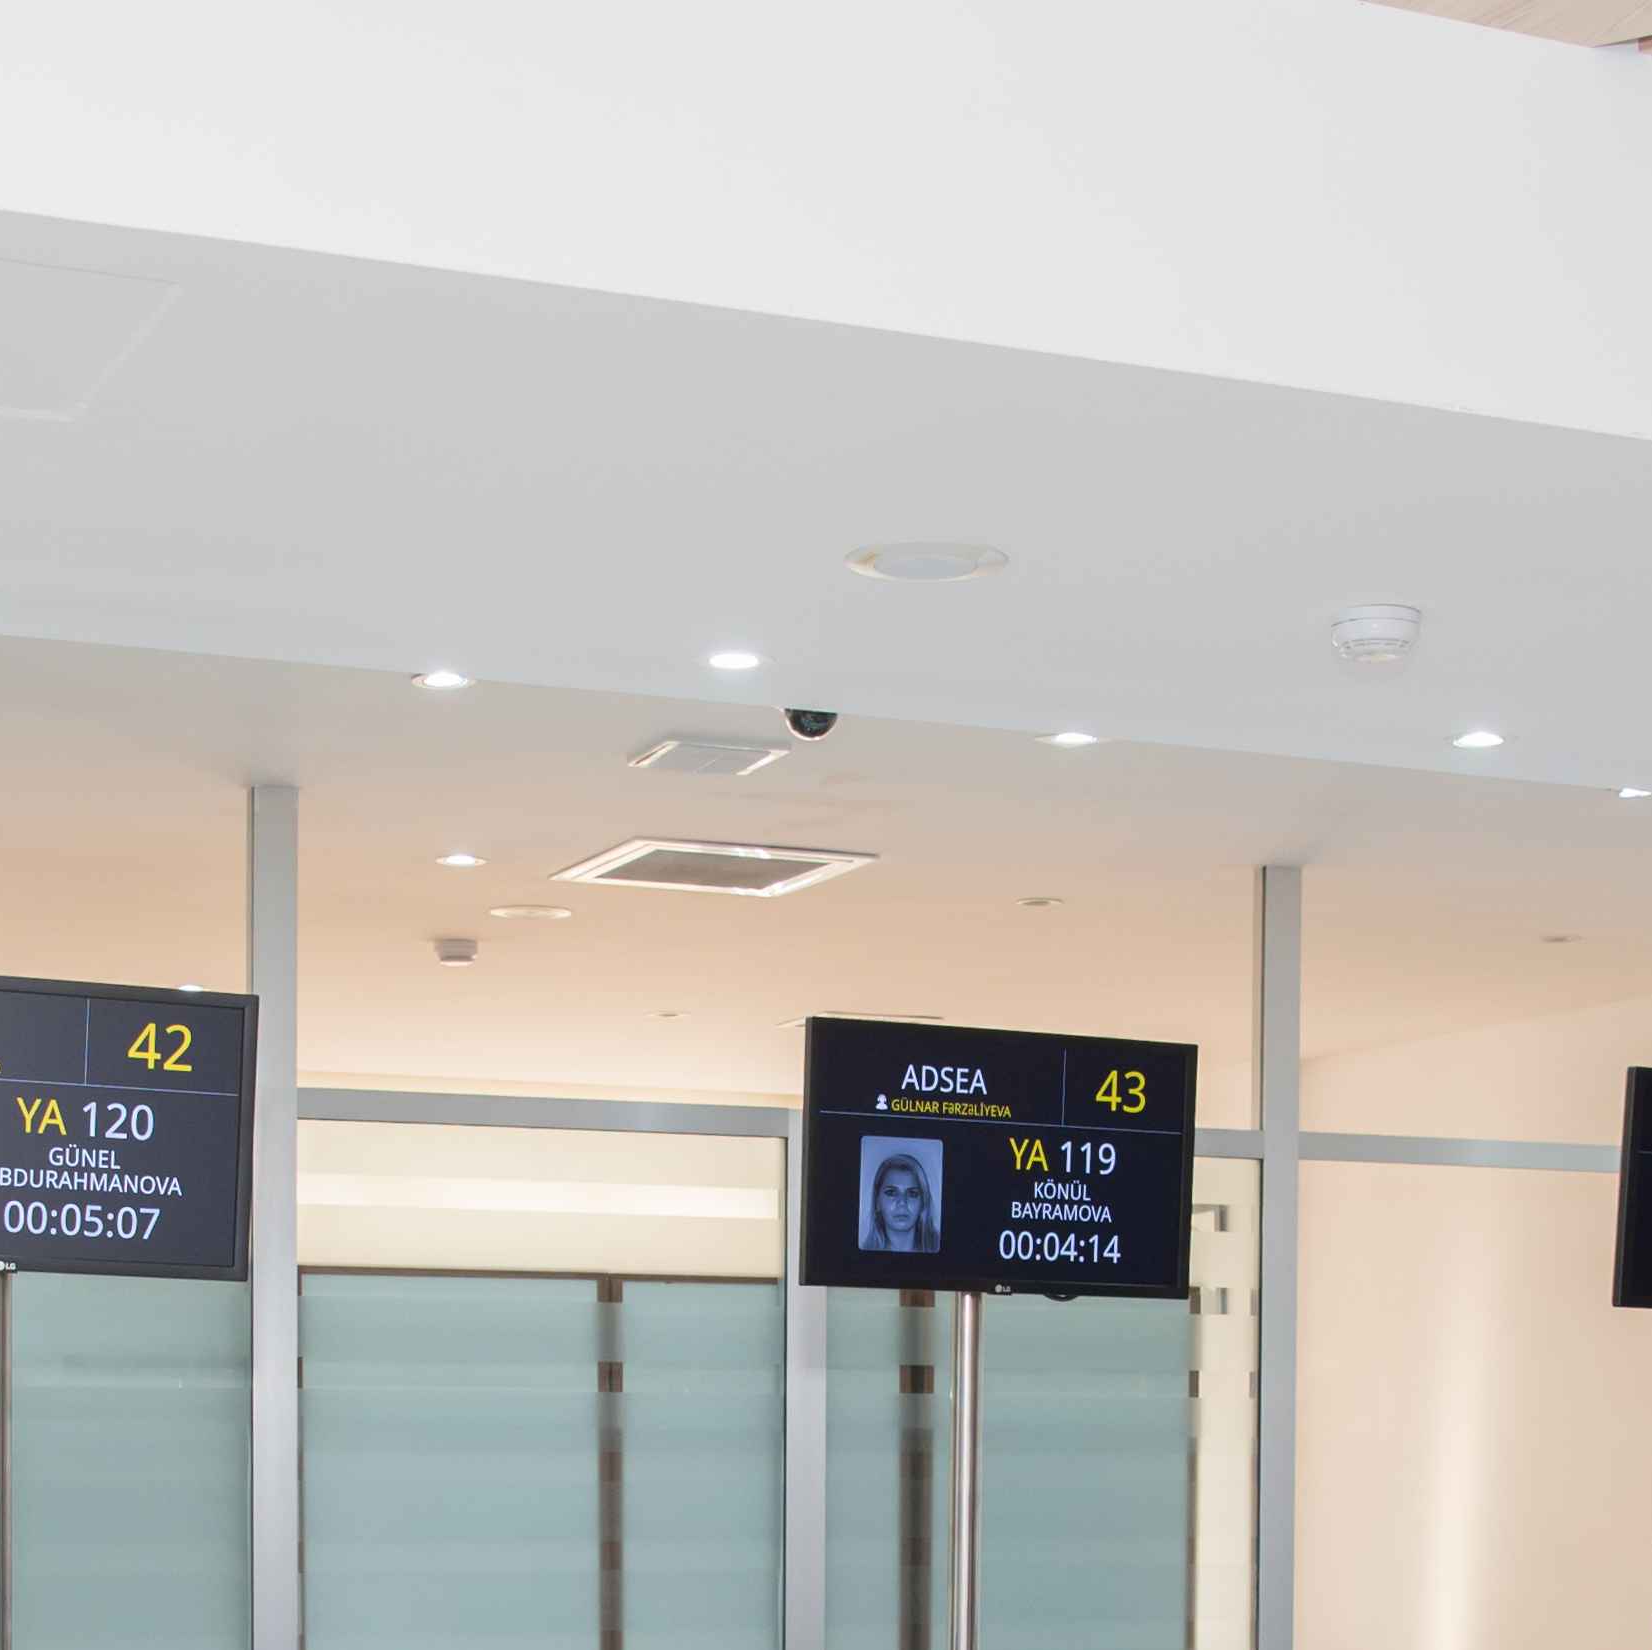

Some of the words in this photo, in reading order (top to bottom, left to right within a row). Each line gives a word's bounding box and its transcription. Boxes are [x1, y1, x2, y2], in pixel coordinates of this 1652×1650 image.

[127, 1022, 193, 1072] 42
[901, 1063, 988, 1095] ADSEA
[1095, 1069, 1146, 1114] 43
[16, 1096, 67, 1136] YA
[82, 1101, 154, 1141] 120
[891, 1098, 940, 1114] GÜLNAR
[48, 1143, 121, 1170] GÜNEL
[1009, 1137, 1049, 1172] YA
[1060, 1140, 1116, 1175] 119
[1034, 1178, 1092, 1202] KÖNÜL
[3, 1200, 161, 1240] 00:05:07
[1010, 1200, 1112, 1224] BAYRAMOVA
[999, 1229, 1121, 1264] 00:04:14
